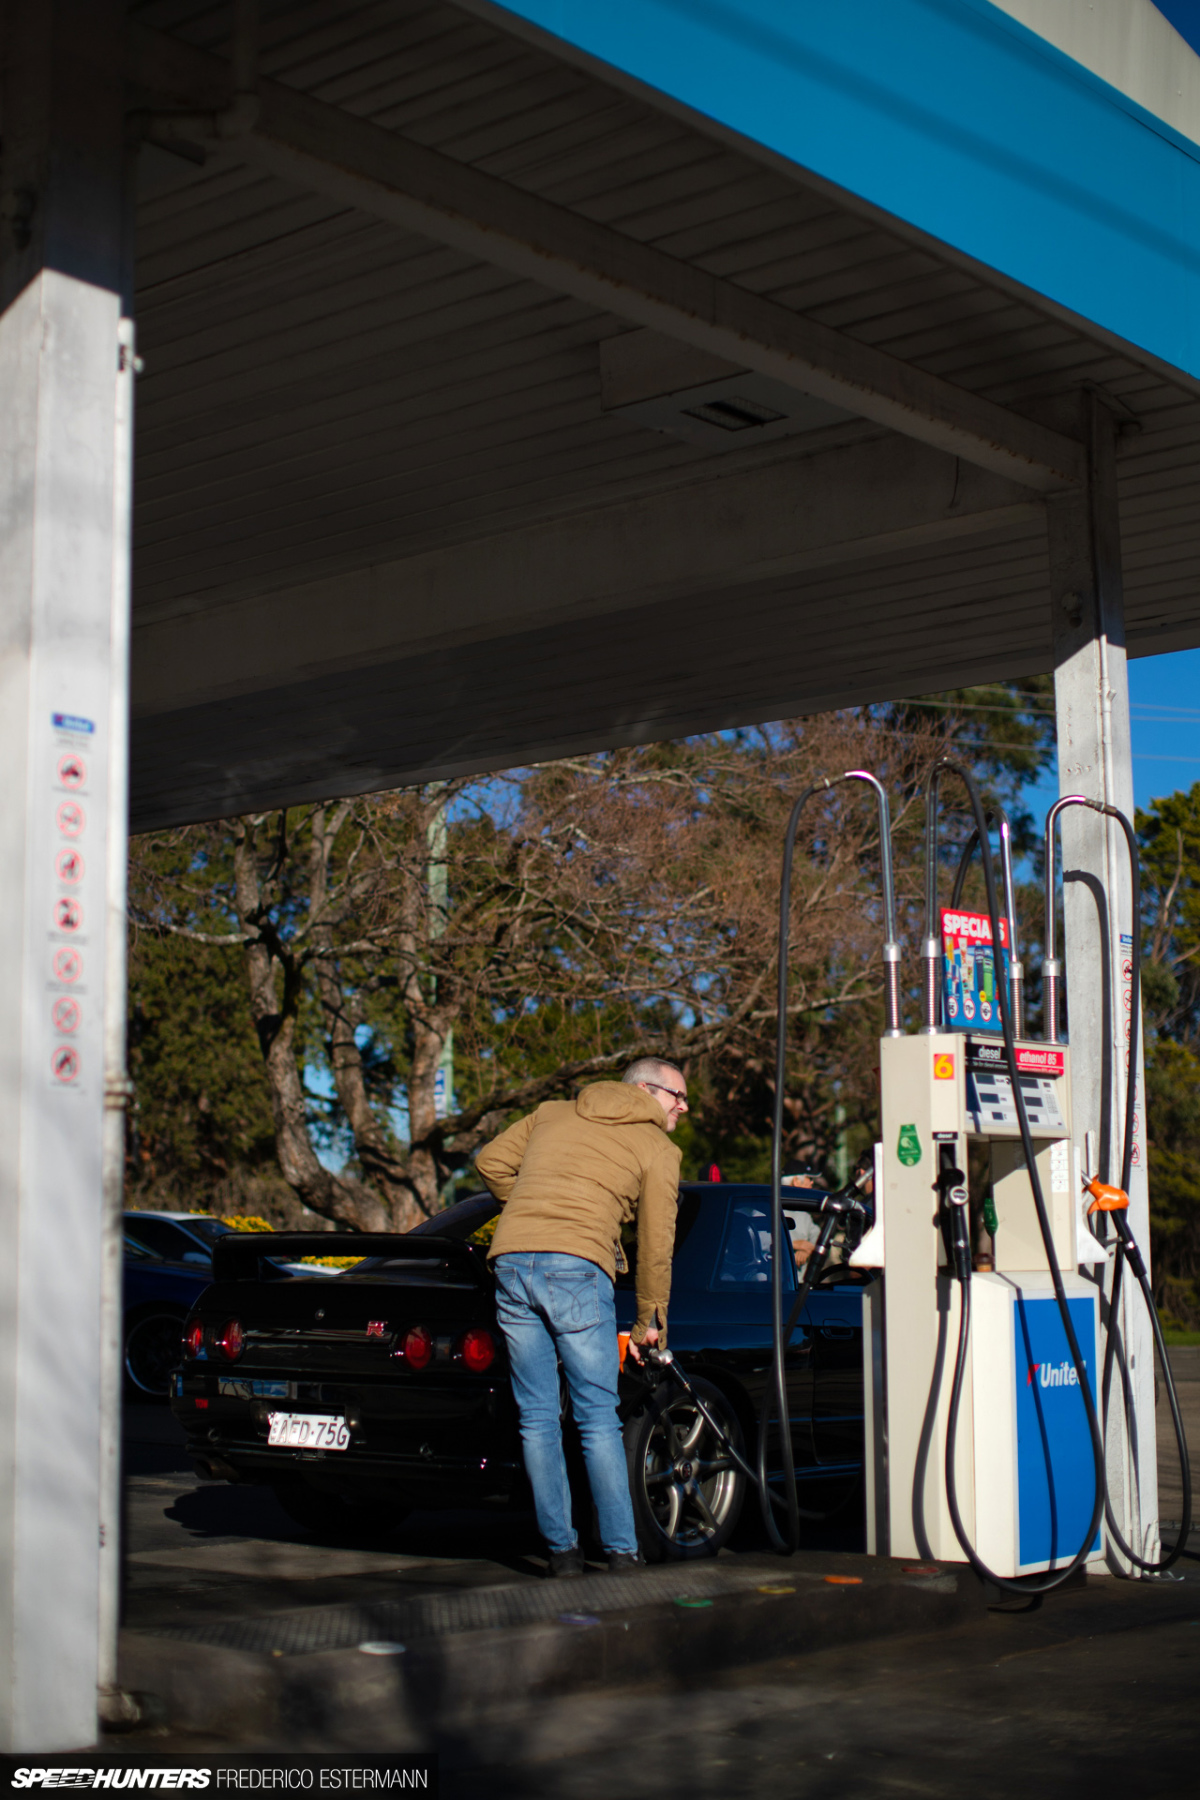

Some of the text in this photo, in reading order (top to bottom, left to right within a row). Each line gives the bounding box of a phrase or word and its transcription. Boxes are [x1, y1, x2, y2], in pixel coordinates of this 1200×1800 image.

[978, 1046, 1001, 1060] diesel
[1019, 1051, 1057, 1065] ethanol 85
[934, 1055, 954, 1079] 6
[1040, 1360, 1086, 1388] Unite
